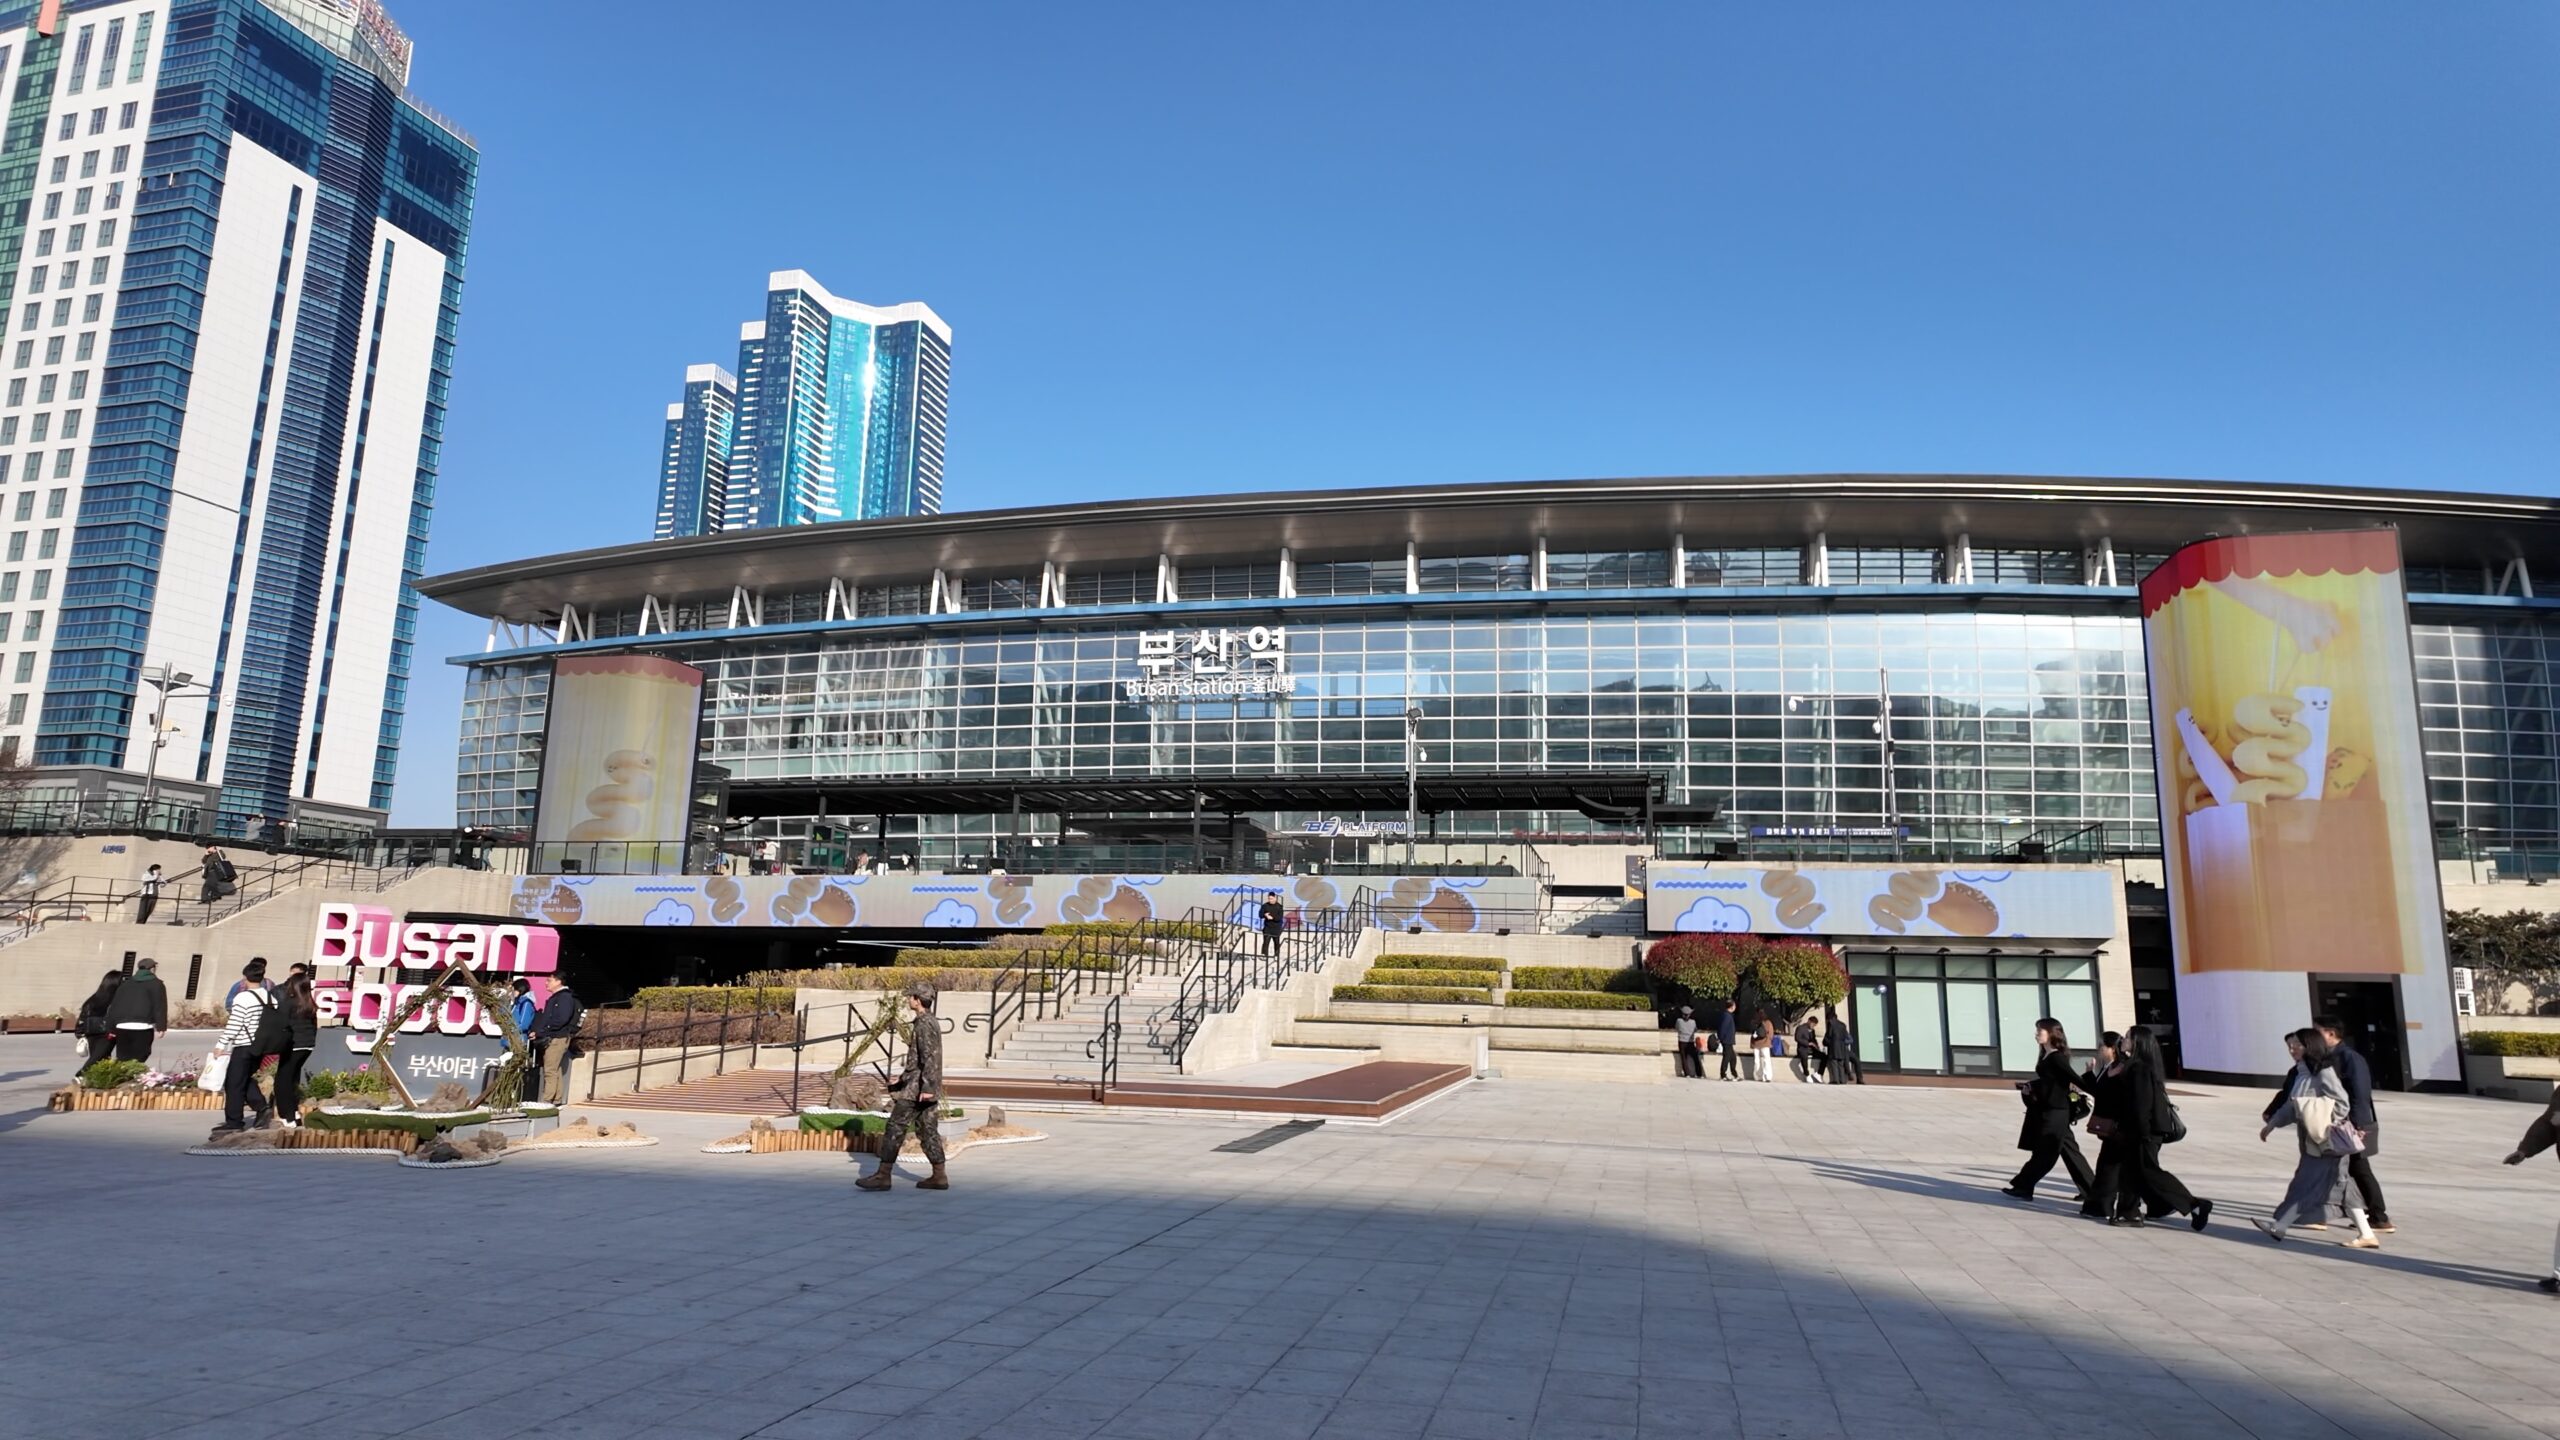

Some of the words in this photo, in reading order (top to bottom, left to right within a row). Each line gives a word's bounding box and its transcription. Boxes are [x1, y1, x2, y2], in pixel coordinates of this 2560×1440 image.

[1137, 626, 1285, 675] 부산역
[1126, 680, 1179, 697] Busan
[1183, 677, 1246, 695] Station
[1342, 821, 1406, 832] PLATFORM
[312, 902, 529, 972] Busan
[310, 980, 339, 1019] s
[407, 1054, 479, 1080] 부산이라
